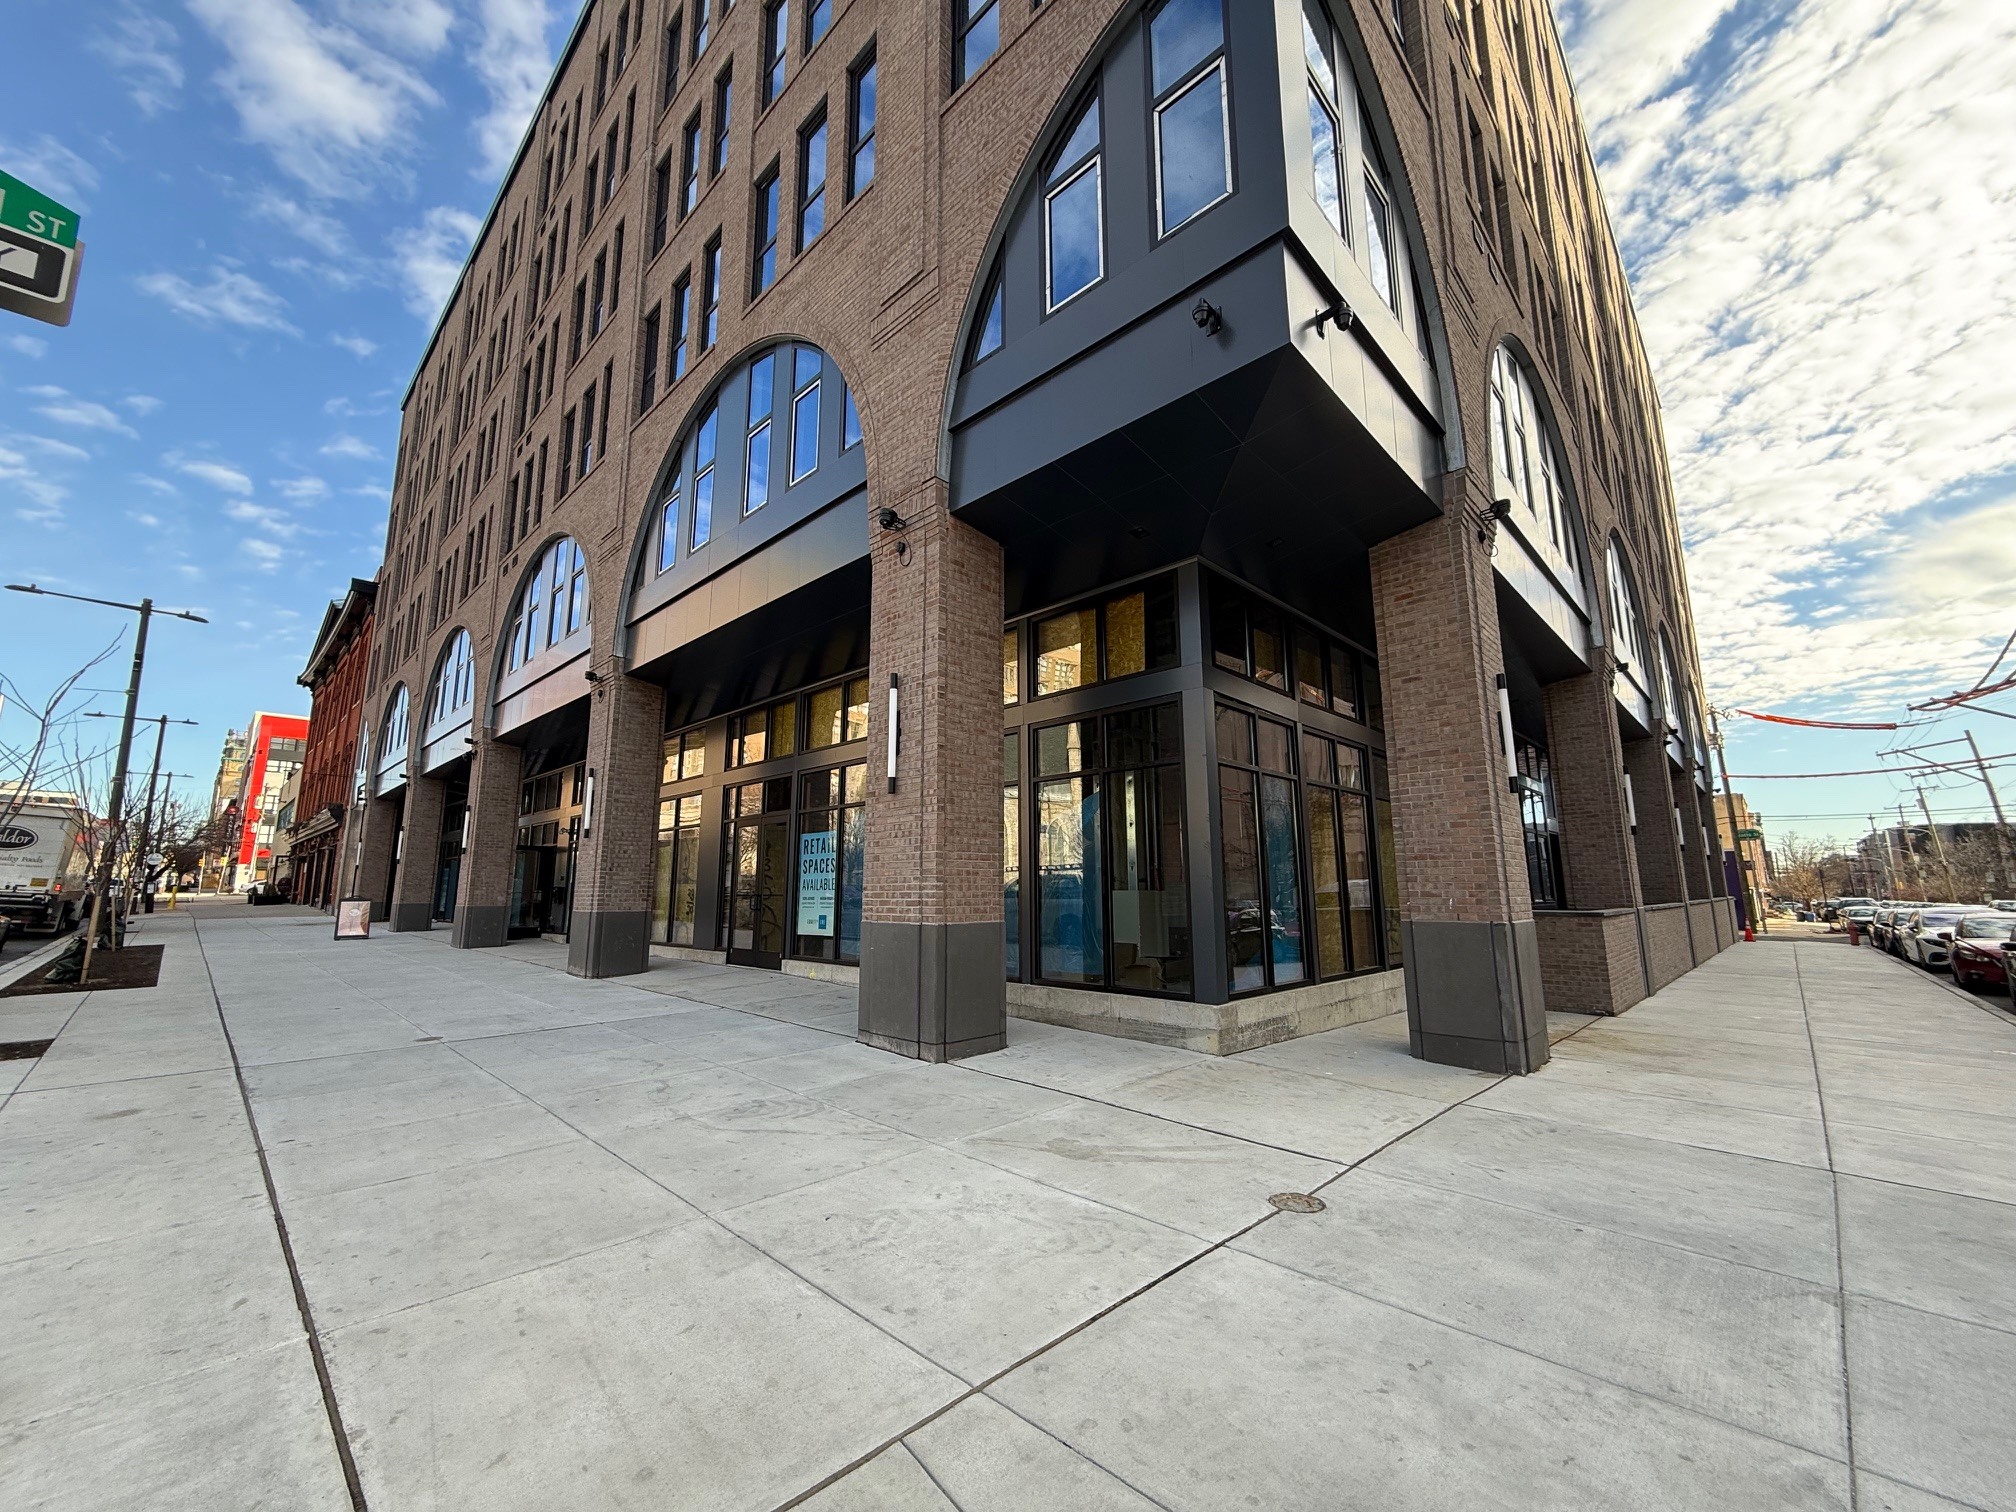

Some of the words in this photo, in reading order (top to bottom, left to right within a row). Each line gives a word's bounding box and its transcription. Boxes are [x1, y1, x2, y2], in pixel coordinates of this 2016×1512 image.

[27, 210, 66, 239] ST
[803, 836, 836, 856] RETAIL
[802, 857, 836, 875] SPACES
[801, 877, 835, 892] AVAILABLE
